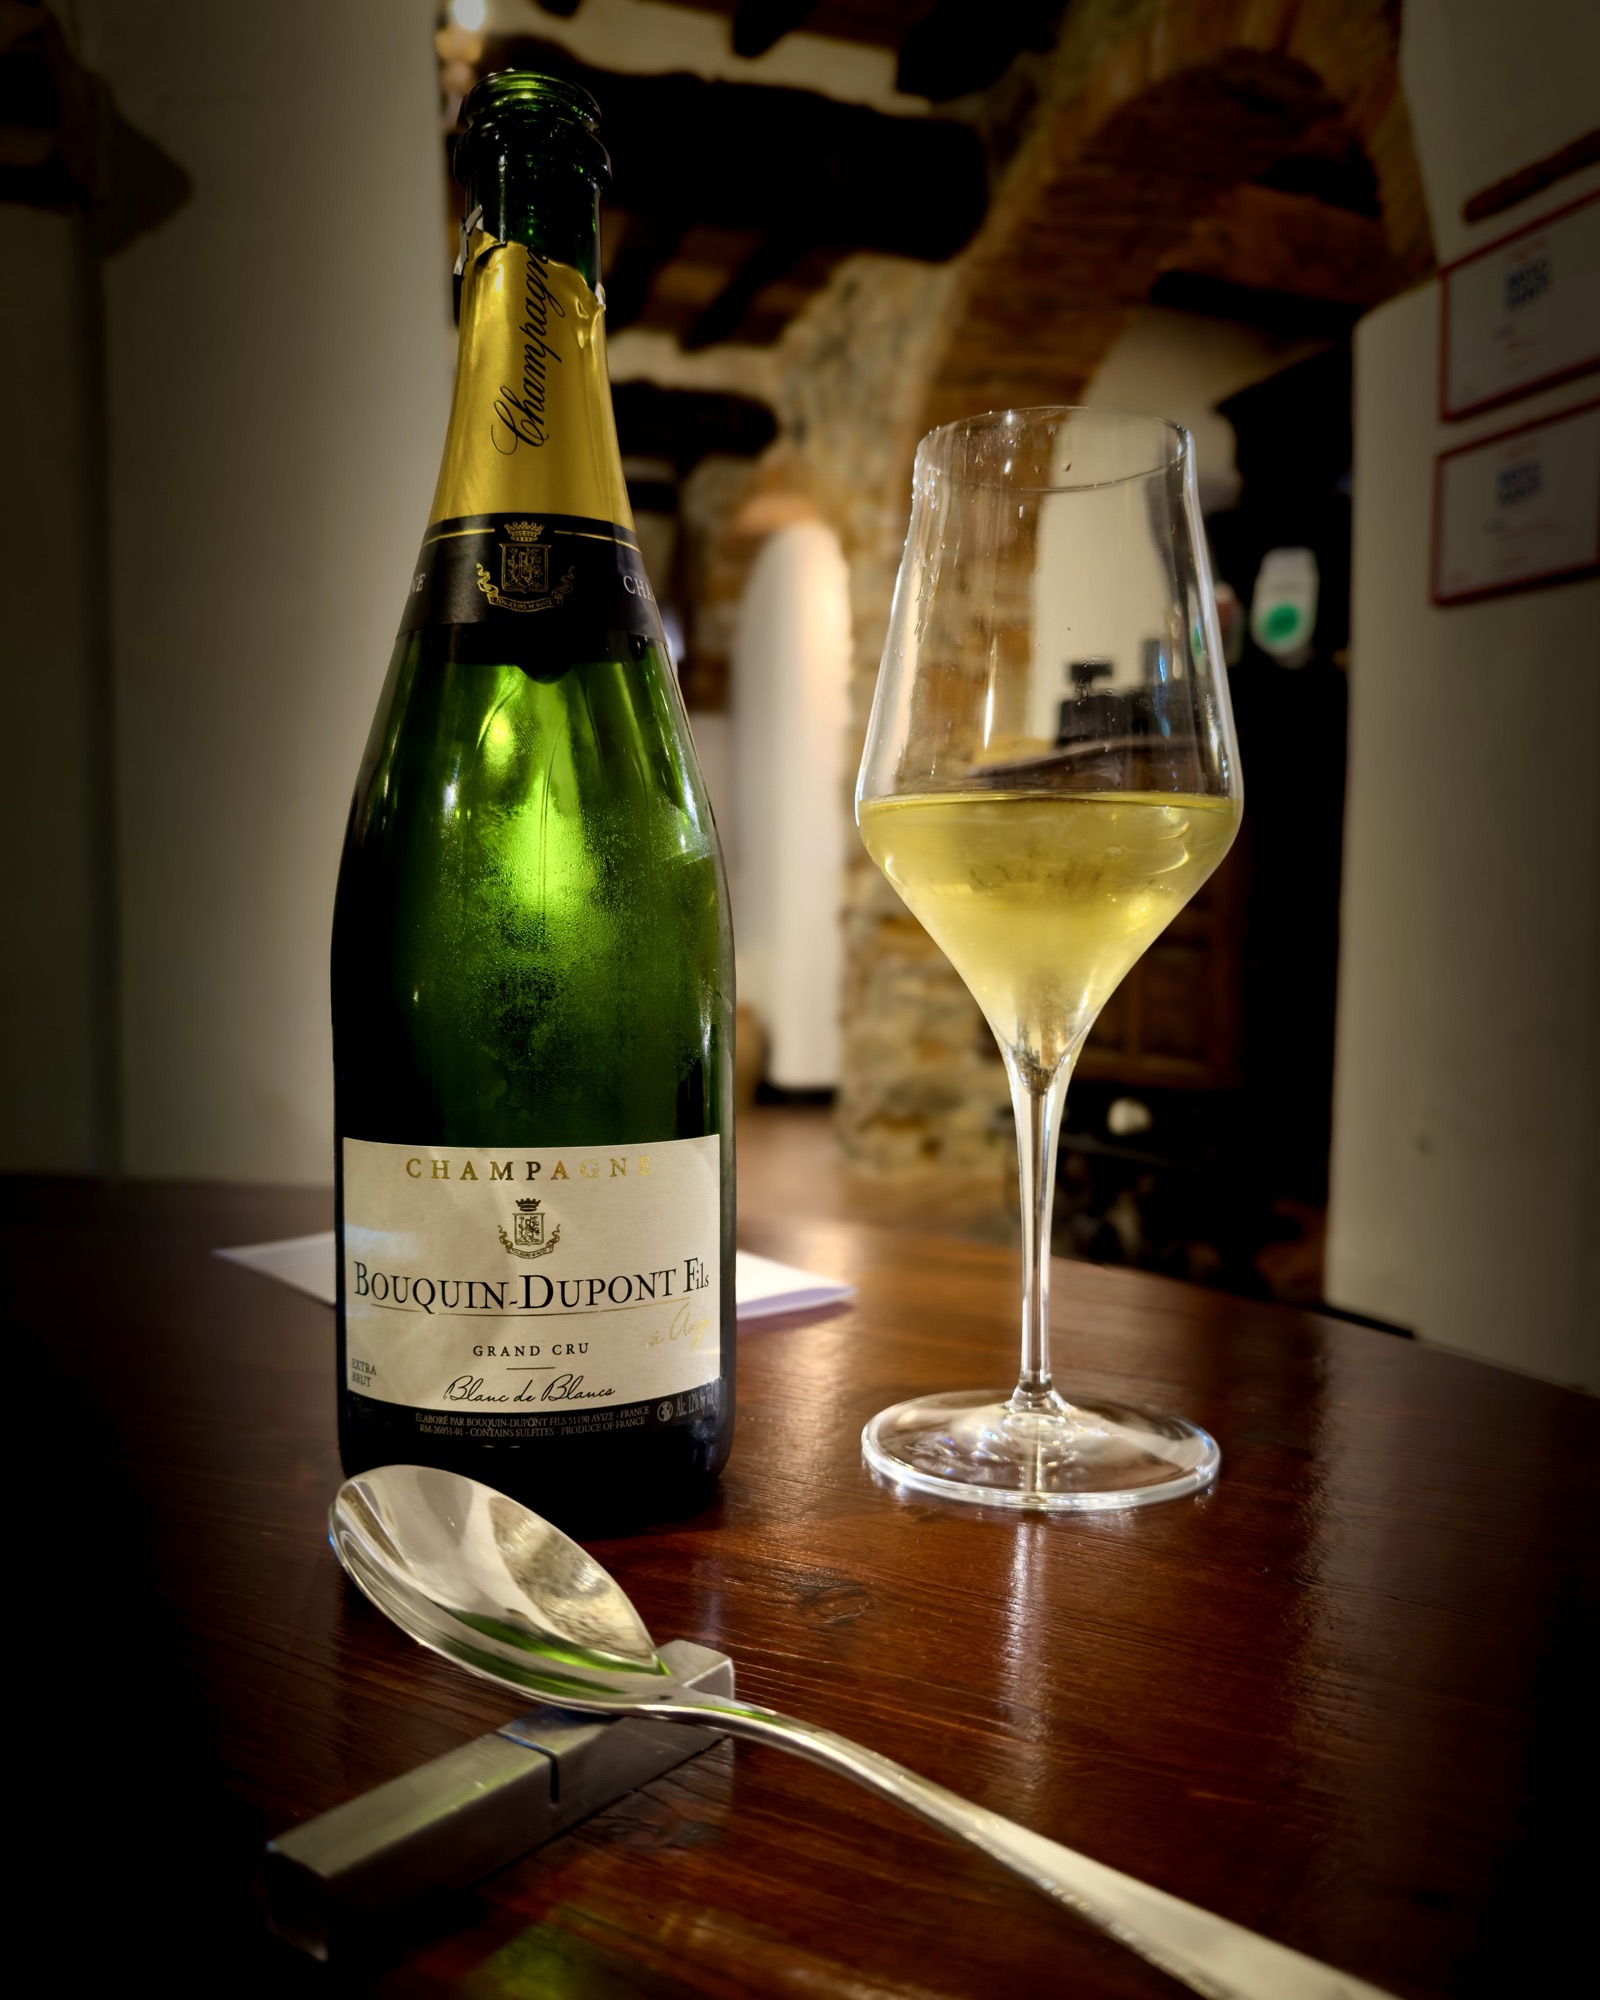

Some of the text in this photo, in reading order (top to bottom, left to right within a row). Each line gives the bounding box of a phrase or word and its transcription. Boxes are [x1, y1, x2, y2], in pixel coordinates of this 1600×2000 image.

[405, 1155, 652, 1181] CHAMPAGNE
[353, 1257, 710, 1315] BOUQUIN-DUPONT Fils
[472, 1342, 590, 1357] GRAND CRU
[351, 1357, 377, 1376] EXTRA
[351, 1371, 371, 1387] BRUT
[443, 1373, 616, 1403] Blanc de Blancs
[415, 1412, 449, 1425] ÉLABORÉ
[450, 1416, 464, 1427] PAR
[549, 1416, 567, 1427] FILS
[569, 1415, 590, 1425] 51190
[591, 1411, 615, 1422] AVIZE
[620, 1405, 650, 1419] FRANCE
[470, 1427, 514, 1437] CONTAINS
[515, 1427, 555, 1437] SULFITES
[561, 1424, 601, 1435] PRODUCE
[603, 1422, 615, 1431] OF
[616, 1416, 645, 1429] FRANCE
